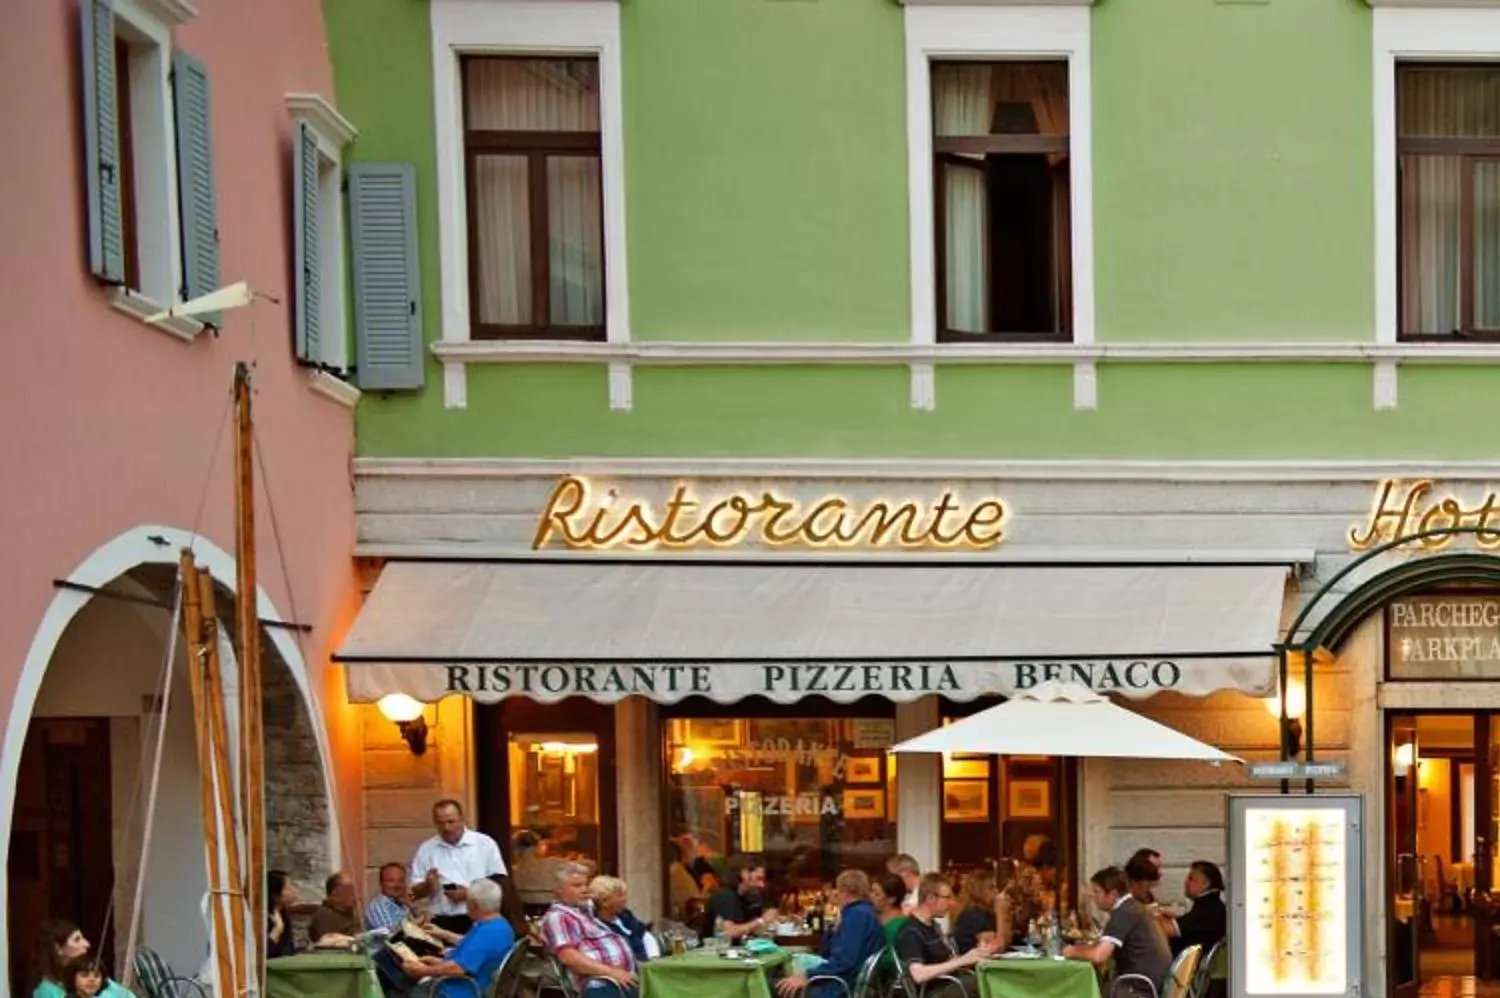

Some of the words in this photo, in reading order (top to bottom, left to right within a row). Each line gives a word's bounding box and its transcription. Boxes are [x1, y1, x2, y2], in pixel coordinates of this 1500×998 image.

[531, 474, 1007, 551] Ristorante
[444, 664, 714, 695] RISTORANTE
[762, 662, 962, 693] PIZZERIA
[1014, 660, 1181, 690] BENACO
[725, 795, 838, 815] PZERIA
